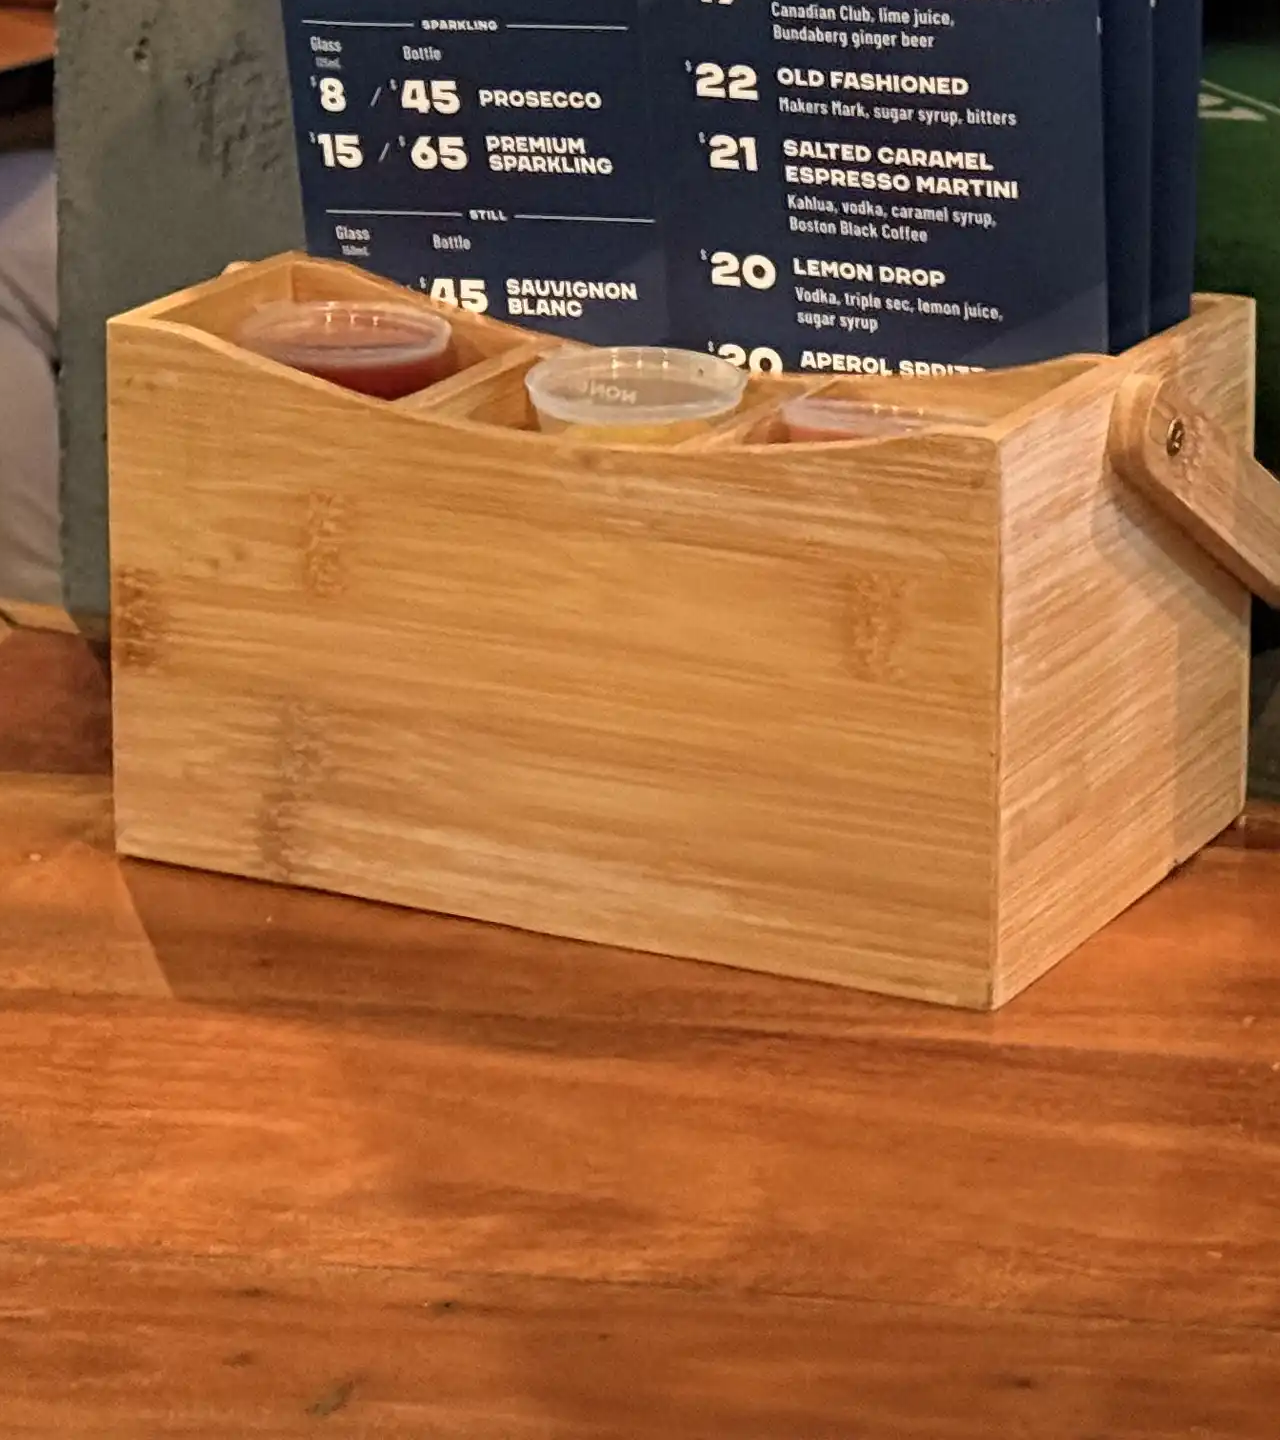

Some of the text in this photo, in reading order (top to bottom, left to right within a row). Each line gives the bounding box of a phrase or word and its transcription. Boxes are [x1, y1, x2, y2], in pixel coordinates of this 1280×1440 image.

[421, 19, 498, 32] SPARKLING
[771, 2, 955, 28] Canadian Club, lime juice,
[310, 36, 442, 62] Glass Bottle
[773, 26, 934, 50] Bundaberg ginger beer
[777, 67, 823, 87] OLD
[830, 70, 969, 96] FASHIONED
[479, 89, 602, 109] PROSECCO
[779, 97, 1016, 126] Makers Mark, sugar syrup, bitters
[486, 136, 586, 155] PREMIUM
[783, 139, 872, 163] SALTED
[877, 146, 995, 171] CARAMEL
[489, 155, 614, 176] SPARKLING
[785, 166, 1019, 199] ESPRESSO MARTINI
[469, 210, 508, 222] STILL
[788, 194, 997, 229] Kahlua, vodka, caramel syrup,
[336, 225, 471, 251] Glass Bottle
[789, 216, 928, 243] Boston Black Coffee
[793, 258, 874, 283] LEMON
[879, 266, 946, 288] DROP
[506, 279, 638, 301] SAUVIGNON
[508, 298, 583, 318] BLANC
[795, 286, 1003, 322] Vodka, triple sec, lemon juice,
[797, 310, 878, 334] sugar syrup
[801, 350, 892, 376] APEROL
